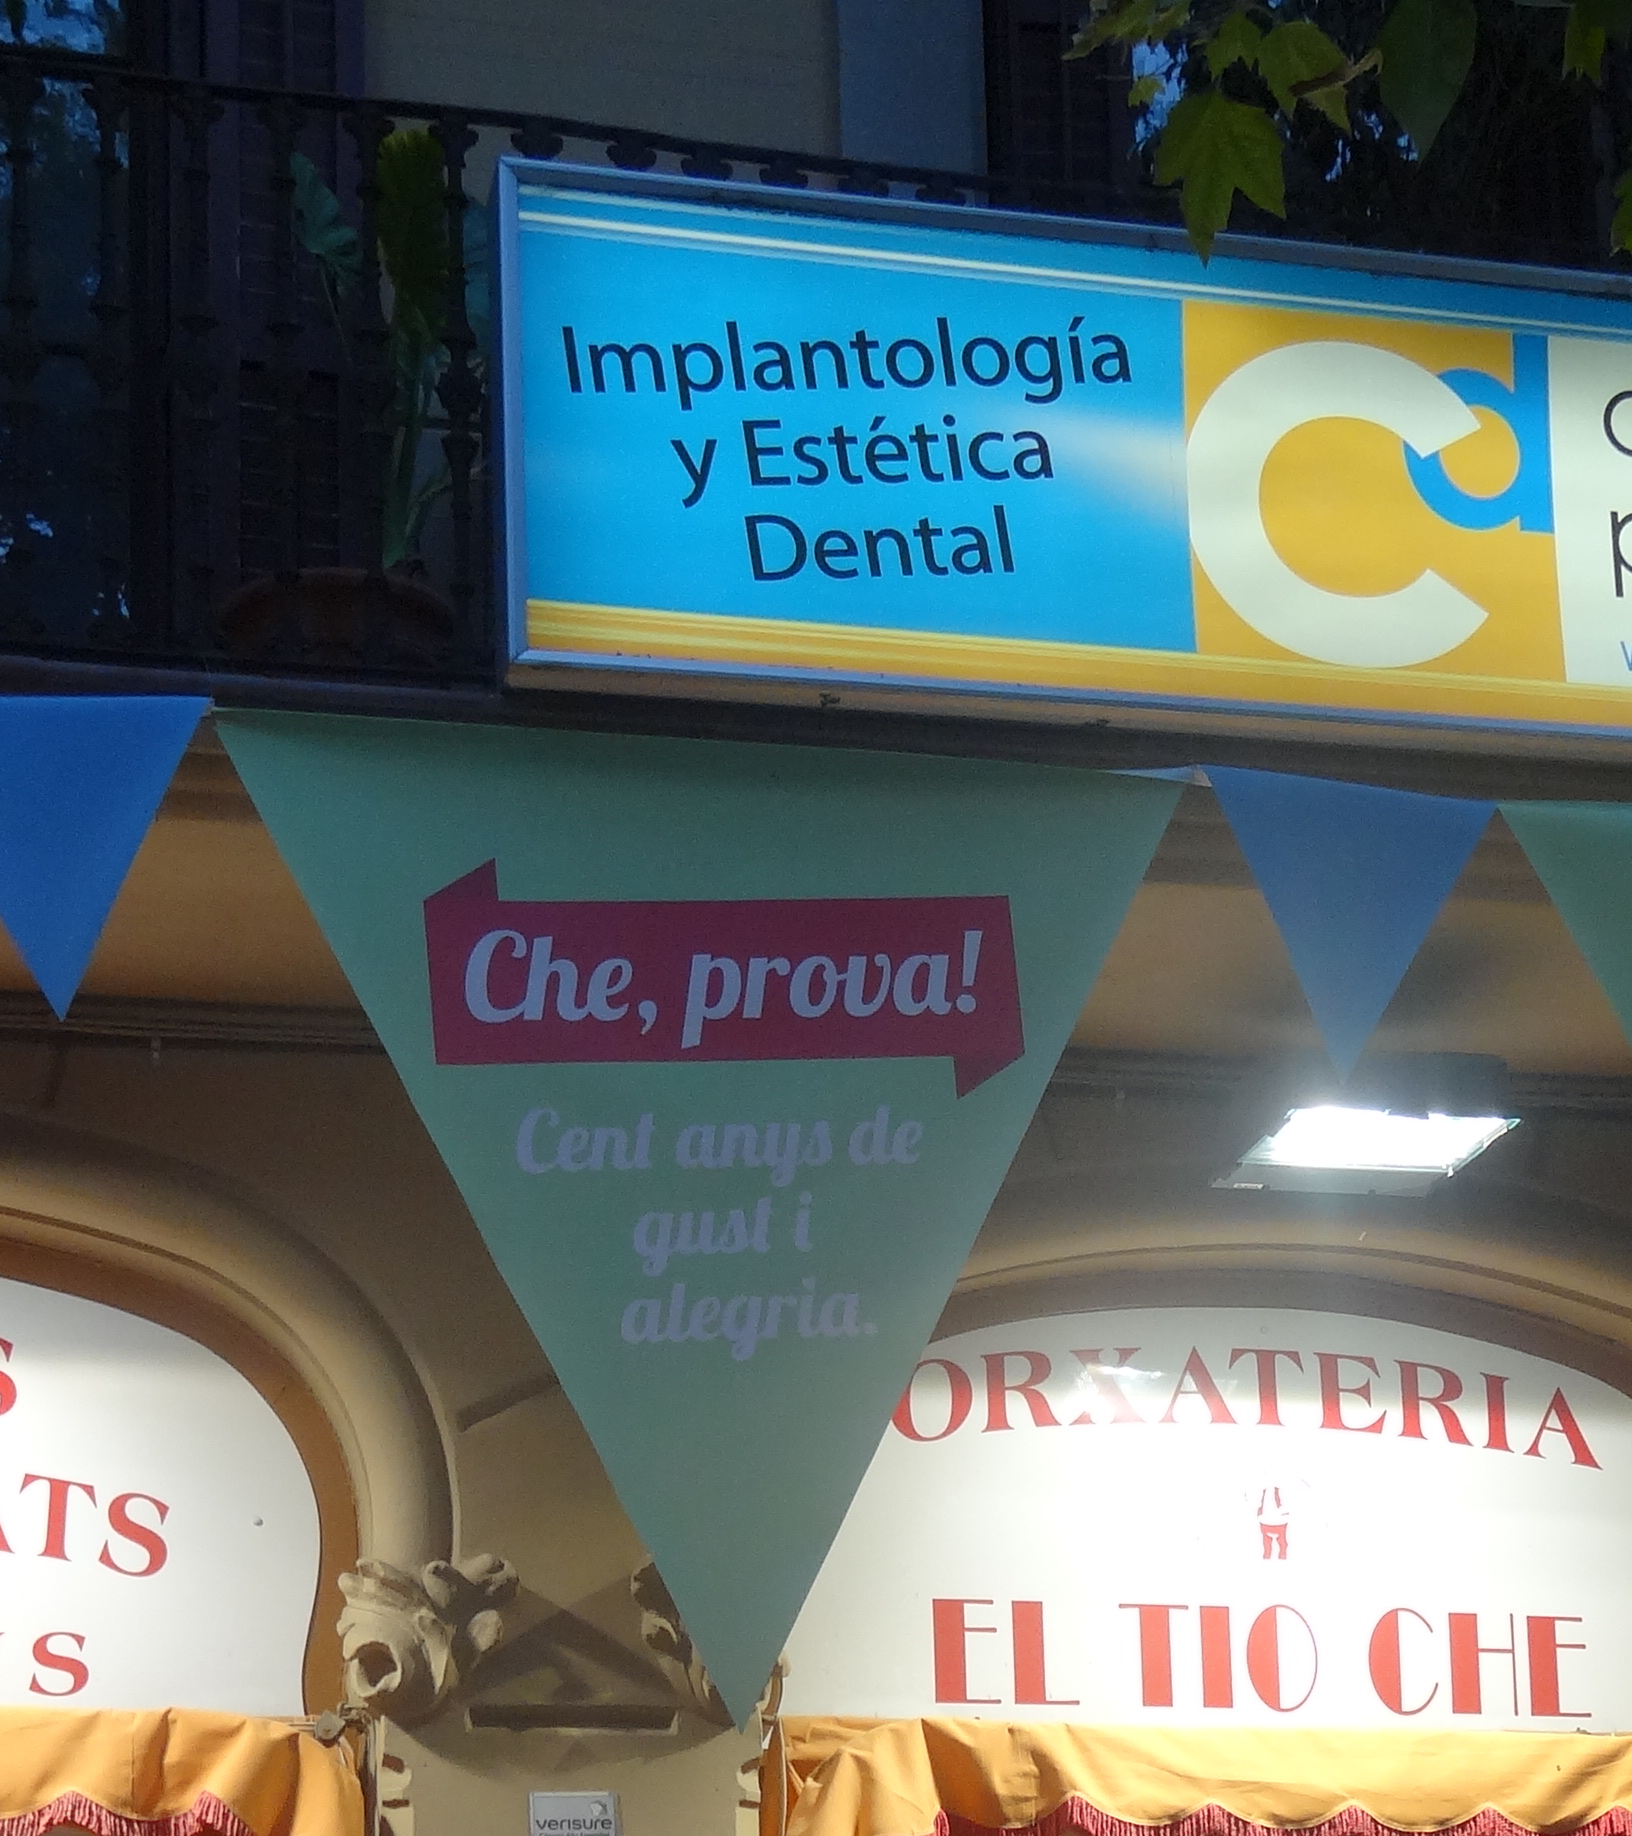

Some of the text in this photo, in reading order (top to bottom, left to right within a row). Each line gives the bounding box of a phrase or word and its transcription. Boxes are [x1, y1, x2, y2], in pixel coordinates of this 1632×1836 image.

[562, 315, 1133, 411] Implantología
[670, 414, 1055, 508] y Estética
[744, 504, 1016, 582] Dental
[463, 928, 984, 1050] Che, prova!
[514, 1106, 924, 1188] Cent anys de
[633, 1191, 813, 1277] gust i
[619, 1278, 878, 1362] alegria.
[890, 1344, 1603, 1471] ORXATERIA
[931, 1597, 1593, 1719] EL TIO CHE
[535, 1817, 613, 1831] verisure
